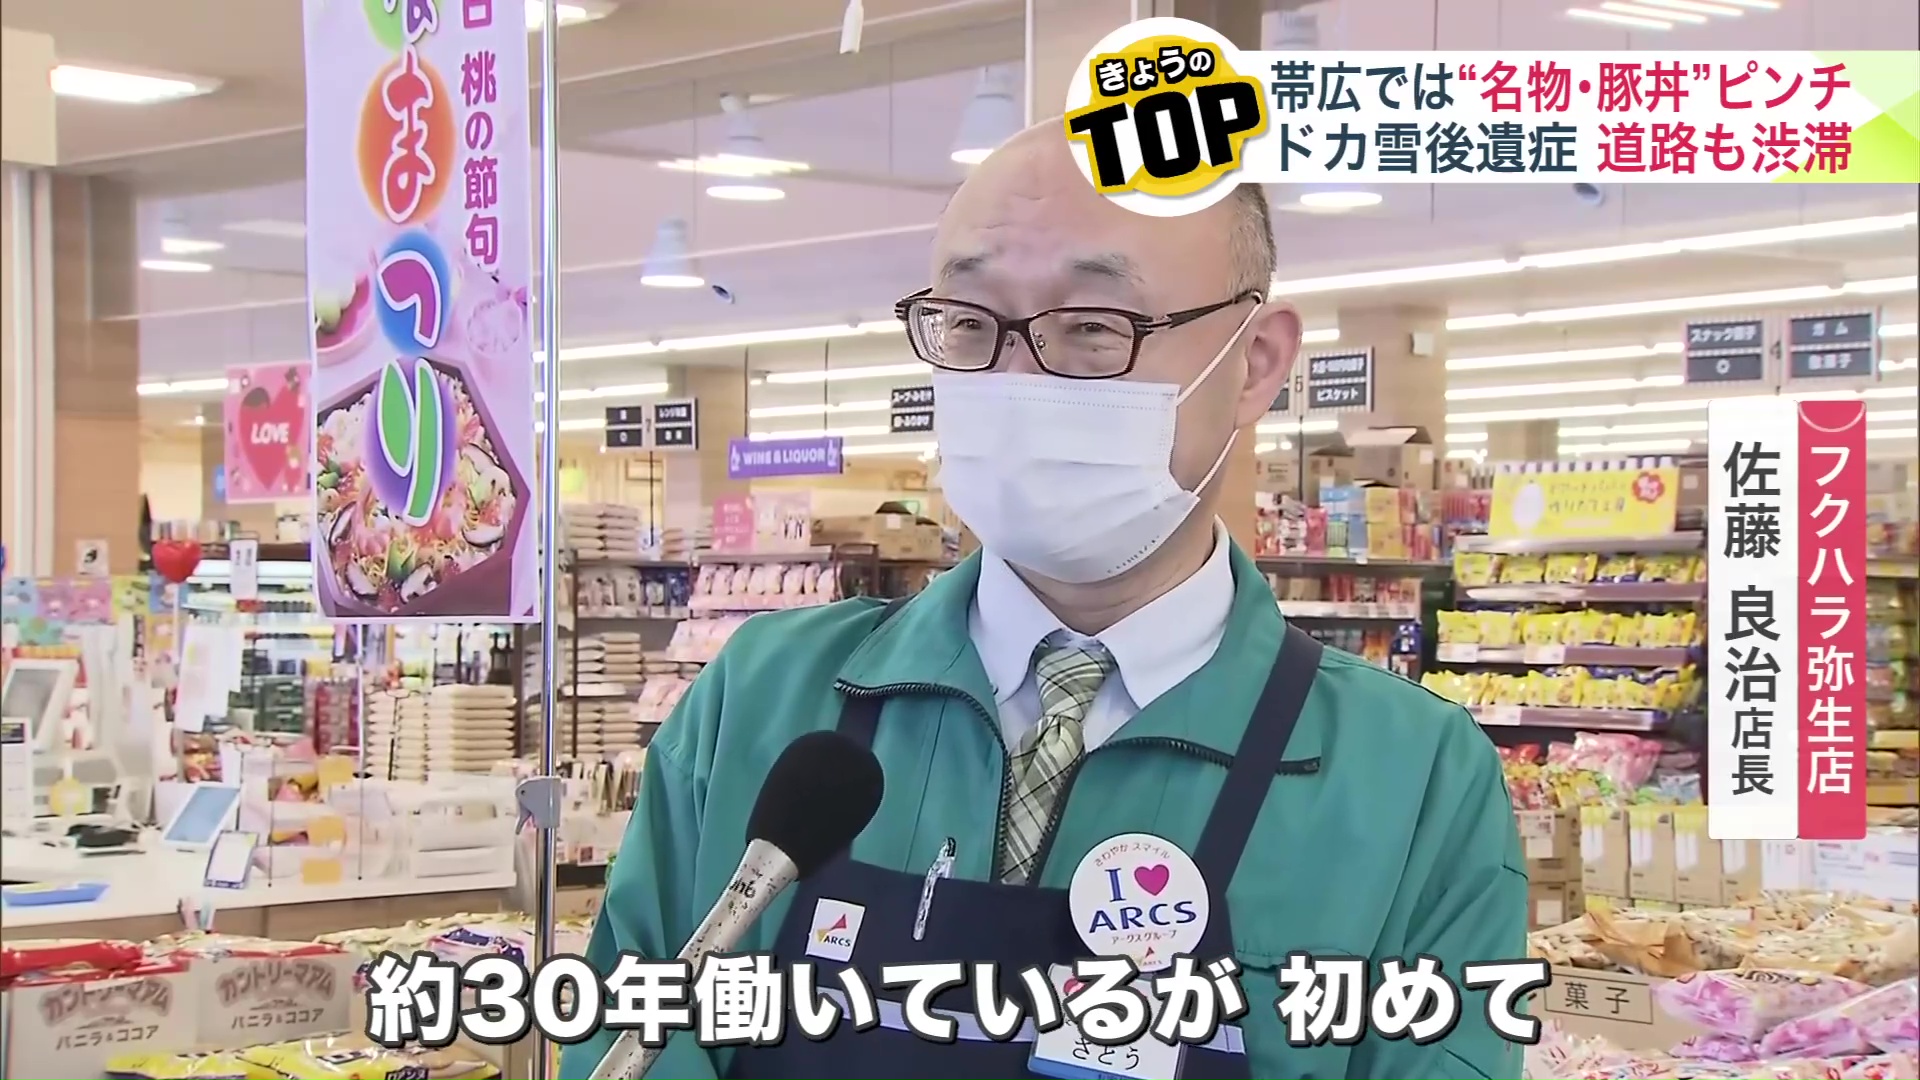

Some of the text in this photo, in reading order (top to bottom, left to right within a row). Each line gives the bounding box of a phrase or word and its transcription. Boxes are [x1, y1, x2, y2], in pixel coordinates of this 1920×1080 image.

[461, 51, 499, 266] 桃の節句
[251, 422, 290, 445] LOVE
[742, 450, 772, 465] WINE
[783, 446, 826, 464] LIQUOR
[1094, 842, 1171, 867] さわやか スマイル
[1105, 867, 1127, 903] I
[1088, 900, 1198, 934] ARCS
[824, 934, 852, 948] ARCS
[1111, 929, 1178, 945] アークスグループ
[1564, 981, 1631, 1016] 菓子
